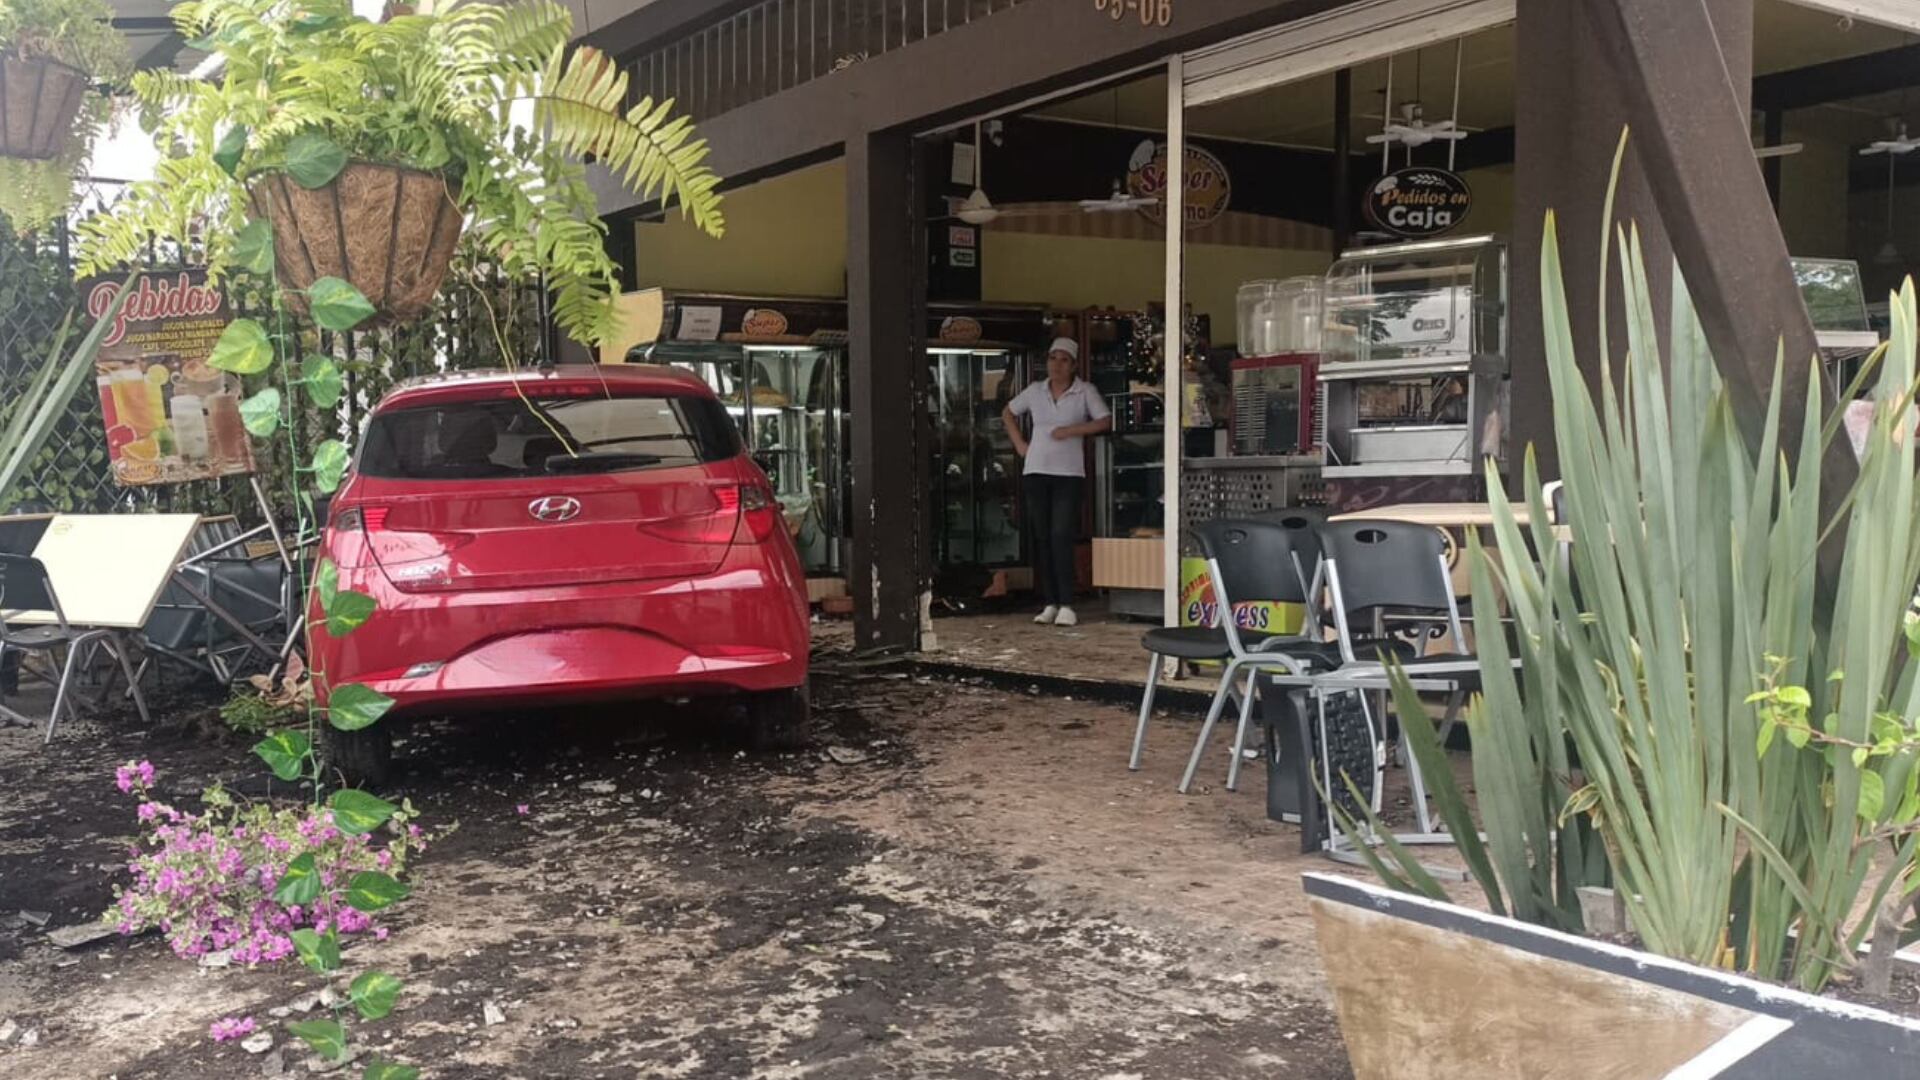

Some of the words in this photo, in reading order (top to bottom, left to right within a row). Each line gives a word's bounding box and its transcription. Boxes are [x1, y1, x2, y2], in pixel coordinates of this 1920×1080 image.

[1381, 188, 1447, 206] Pedidos
[1450, 192, 1469, 204] en
[1388, 205, 1452, 229] Caja
[88, 272, 221, 347] Bebidas
